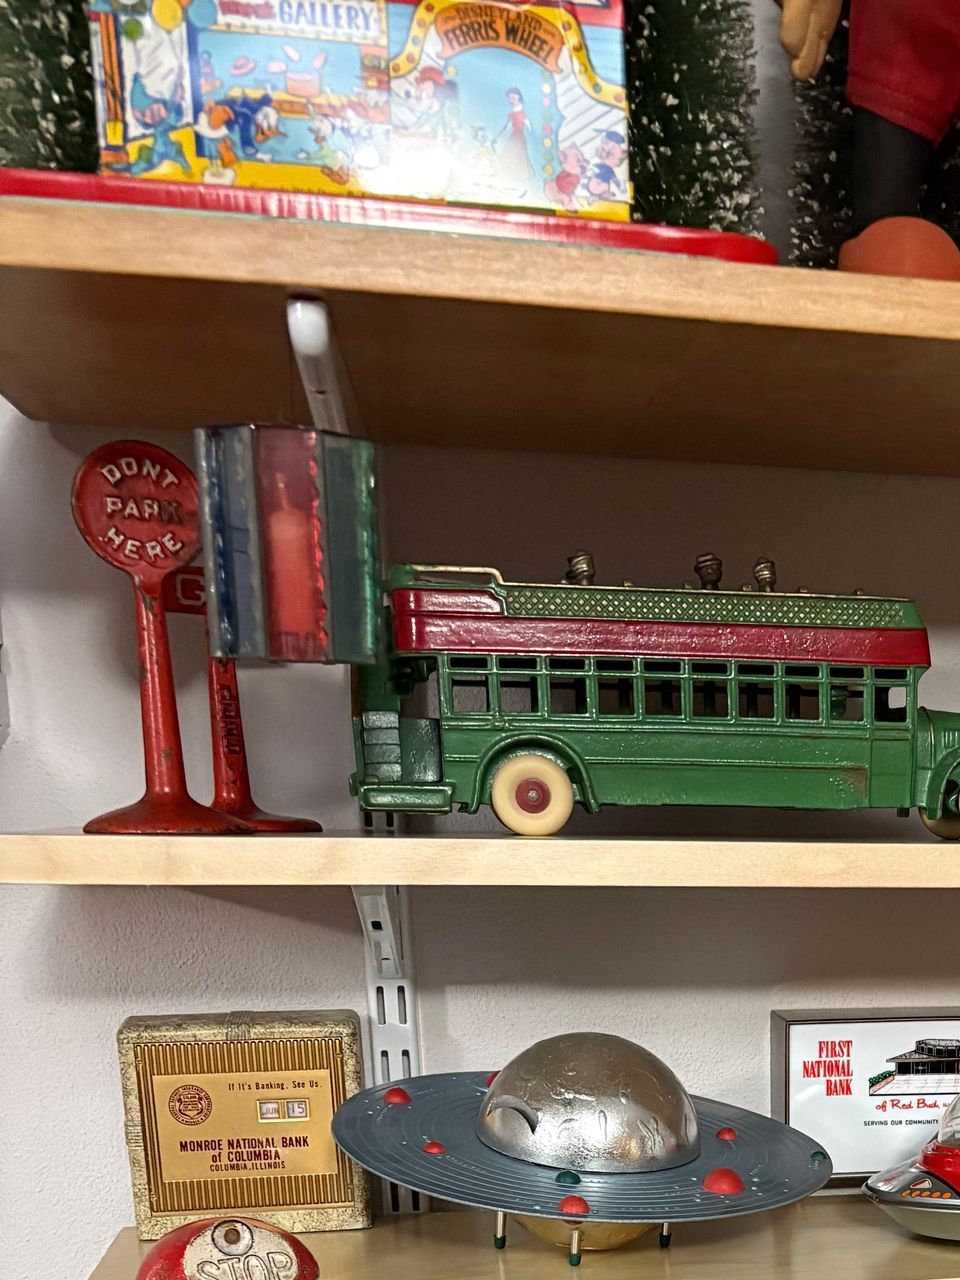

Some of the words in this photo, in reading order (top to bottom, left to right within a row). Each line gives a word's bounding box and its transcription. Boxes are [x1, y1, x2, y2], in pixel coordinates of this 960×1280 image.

[279, 0, 374, 31] GALLERY
[444, 20, 500, 50] FERRIS
[505, 22, 555, 64] WHEEL
[102, 457, 179, 488] DONT
[106, 497, 181, 523] PARK
[107, 527, 183, 562] HERE
[818, 1040, 853, 1058] FIRST
[802, 1060, 853, 1078] NATIONAL
[292, 1080, 306, 1089] See
[826, 1079, 853, 1096] BANK
[263, 1107, 279, 1115] JUN
[291, 1102, 305, 1114] 15
[875, 1101, 888, 1112] of
[890, 1099, 914, 1110] Red
[905, 1118, 939, 1126] COMMUNITY
[179, 1139, 223, 1152] MONROE
[227, 1138, 277, 1150] NATIONAL
[281, 1136, 309, 1148] BANK
[211, 1152, 222, 1163] of
[227, 1149, 281, 1162] COLUMBIA
